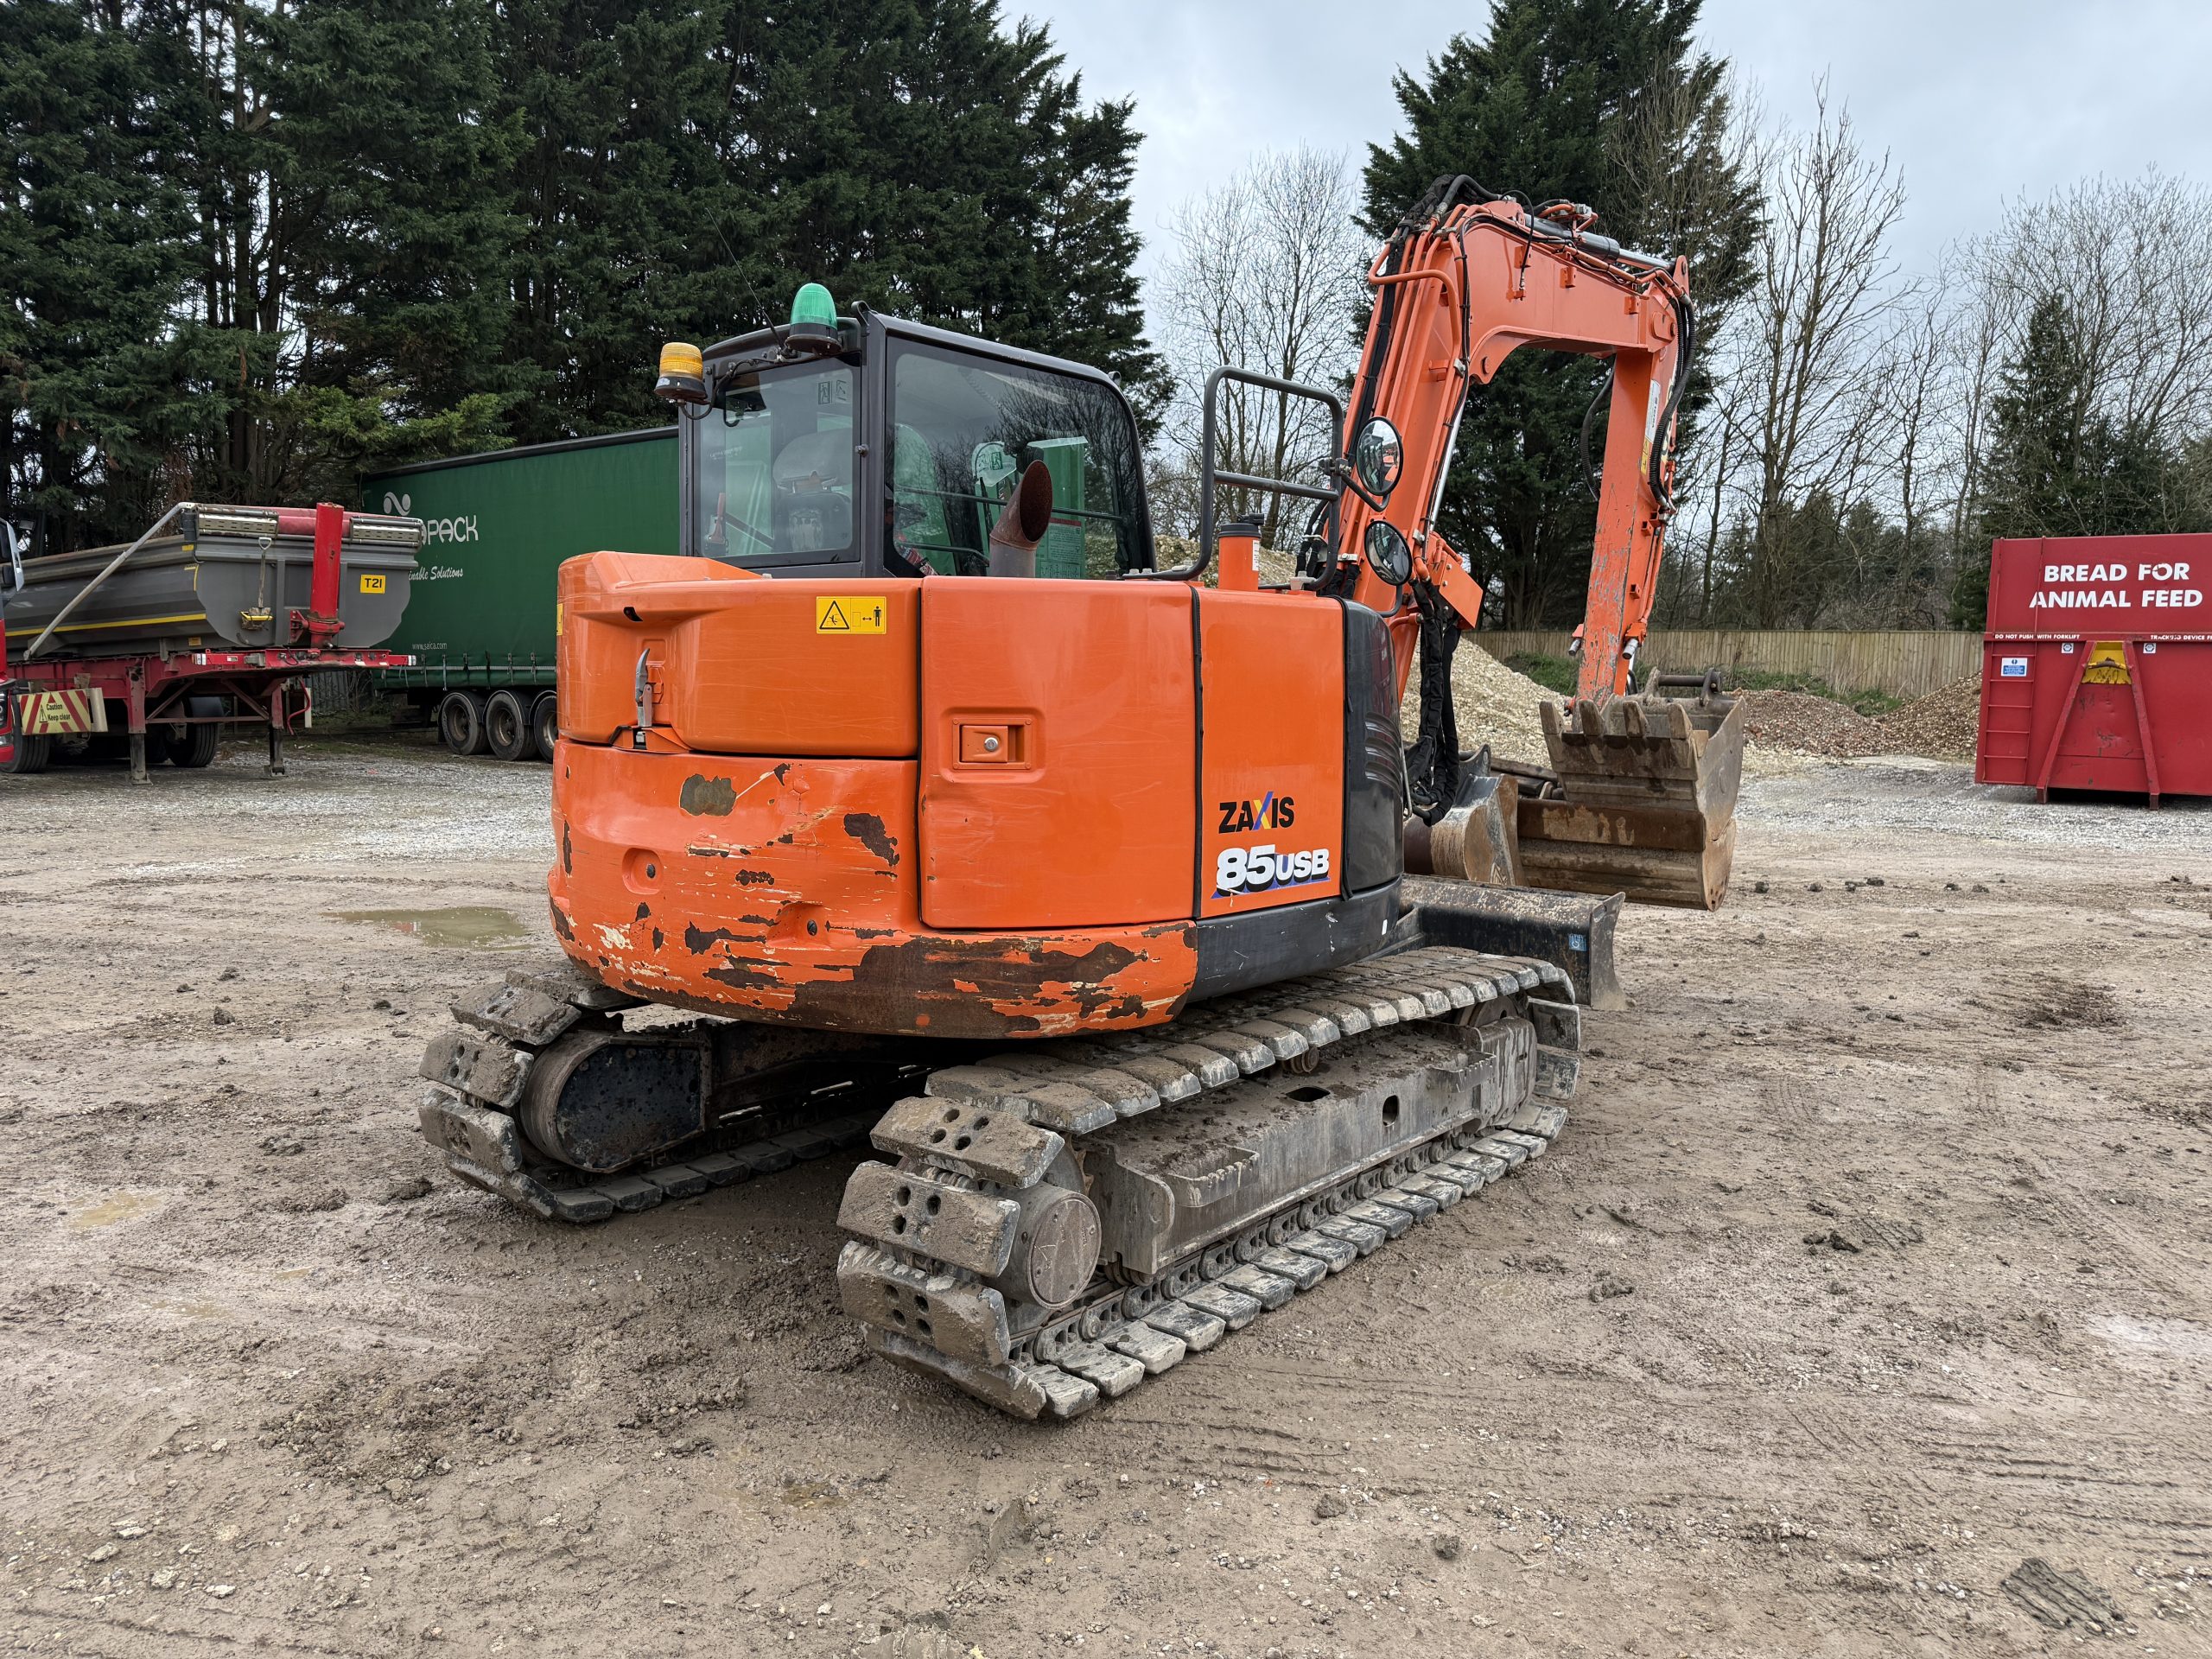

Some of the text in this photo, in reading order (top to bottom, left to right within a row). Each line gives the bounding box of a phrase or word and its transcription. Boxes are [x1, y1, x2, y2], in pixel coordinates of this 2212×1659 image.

[430, 566, 464, 580] Solutions
[2044, 563, 2190, 582] BREAD FOR
[365, 578, 382, 588] T21
[2029, 589, 2202, 608] ANIMAL FEED
[1218, 791, 1294, 834] ZAXIS
[1216, 844, 1330, 895] 85USB
